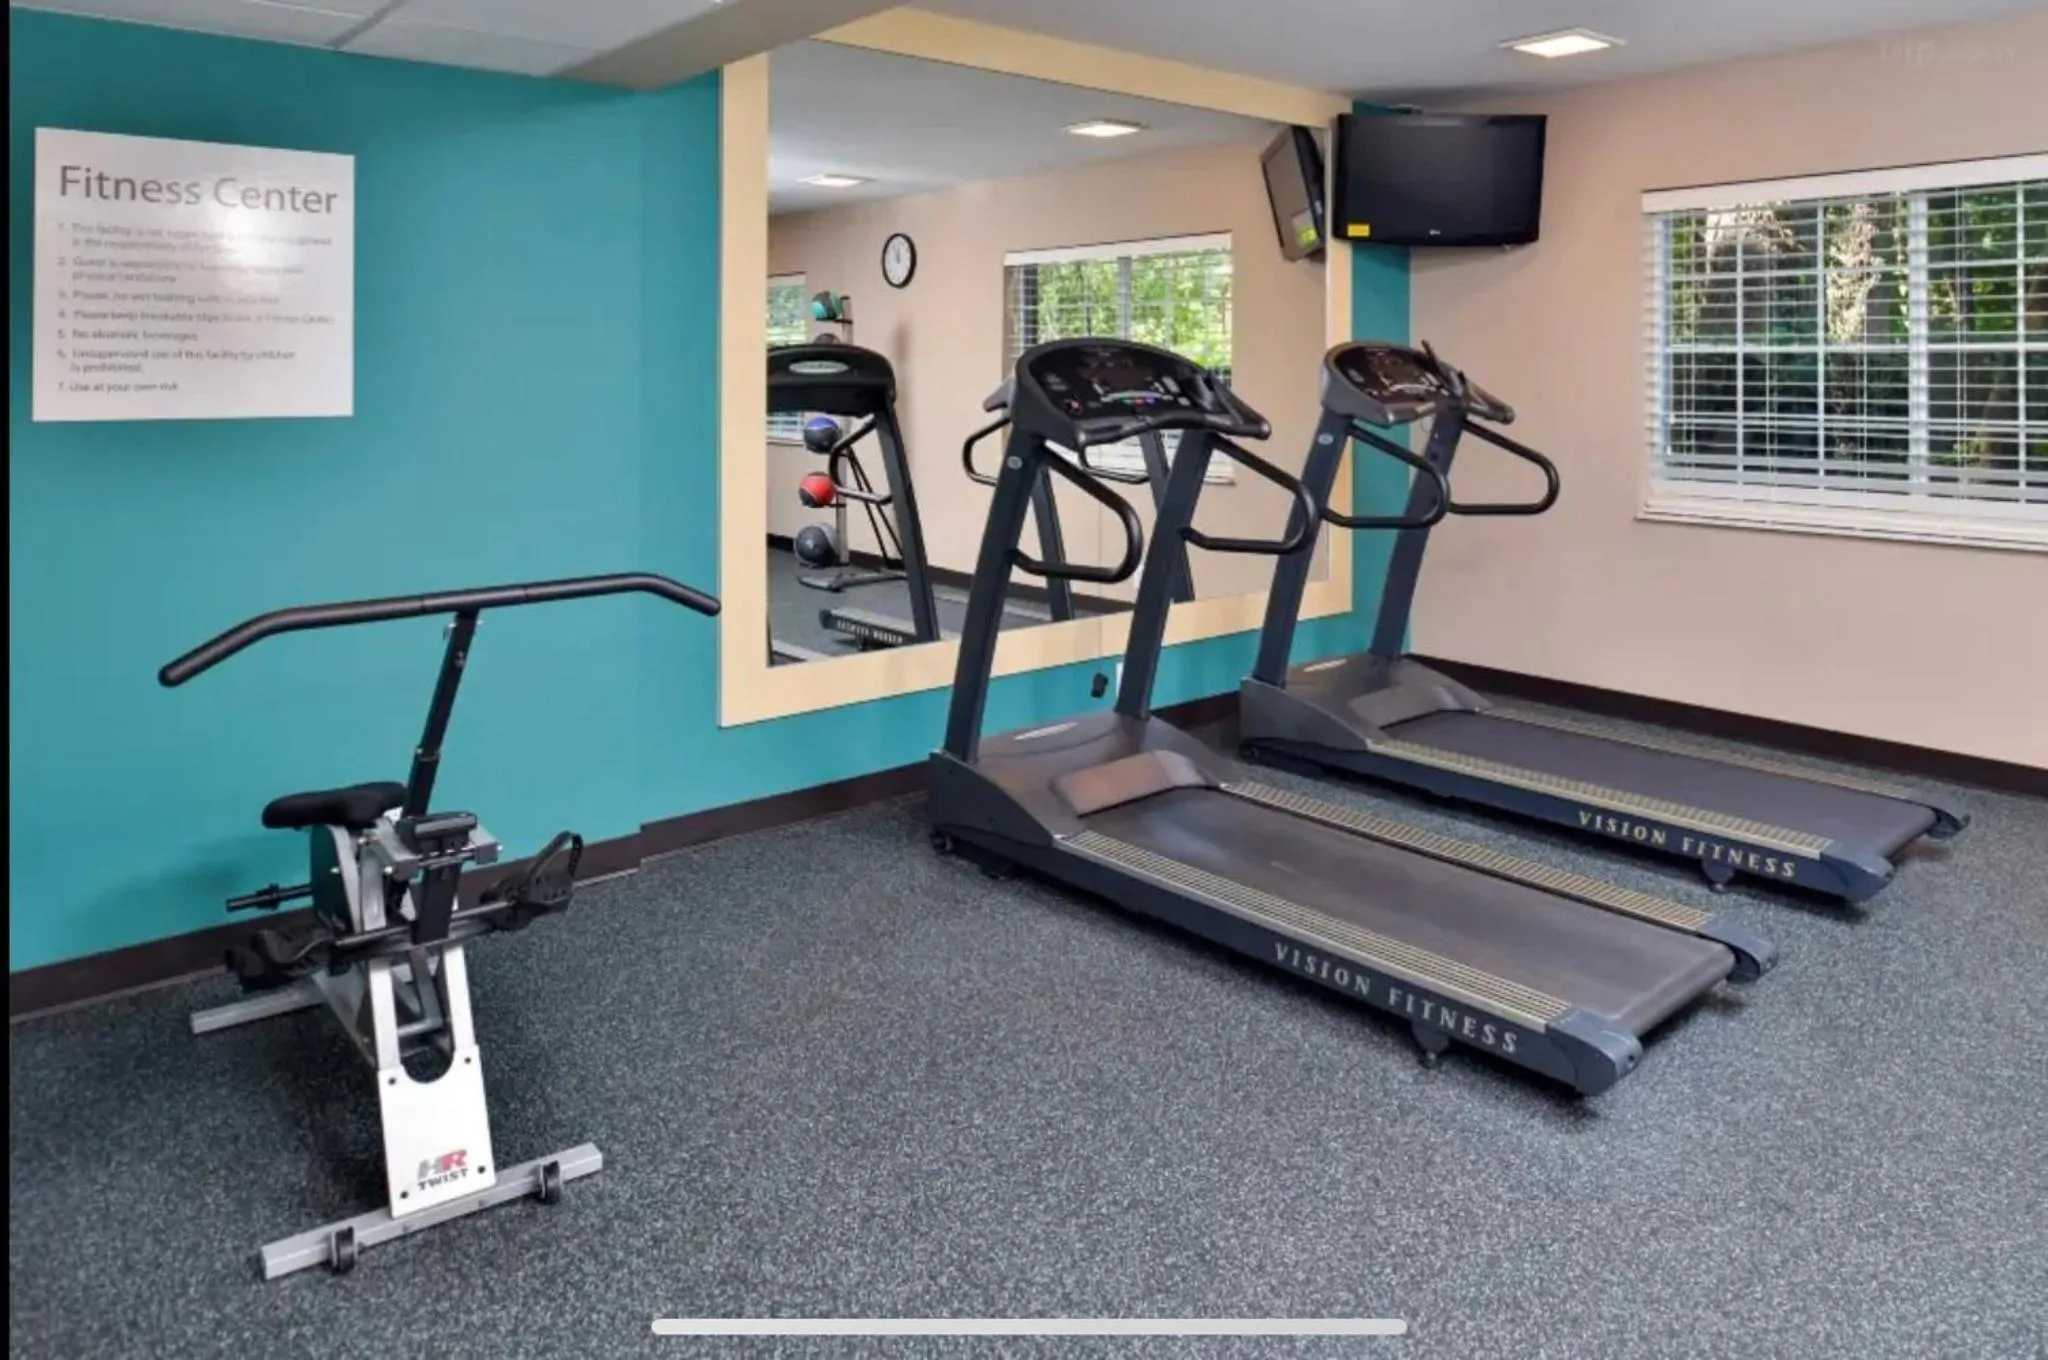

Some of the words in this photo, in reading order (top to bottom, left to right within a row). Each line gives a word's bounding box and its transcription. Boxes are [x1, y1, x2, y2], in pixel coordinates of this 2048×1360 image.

[59, 164, 202, 206] Fitness
[212, 176, 338, 215] Center
[1578, 809, 1667, 846] VISION
[1681, 836, 1797, 878] FITNESS
[1273, 941, 1372, 995] VISION
[1387, 986, 1520, 1054] FITNESS
[417, 1167, 468, 1190] TWIST
